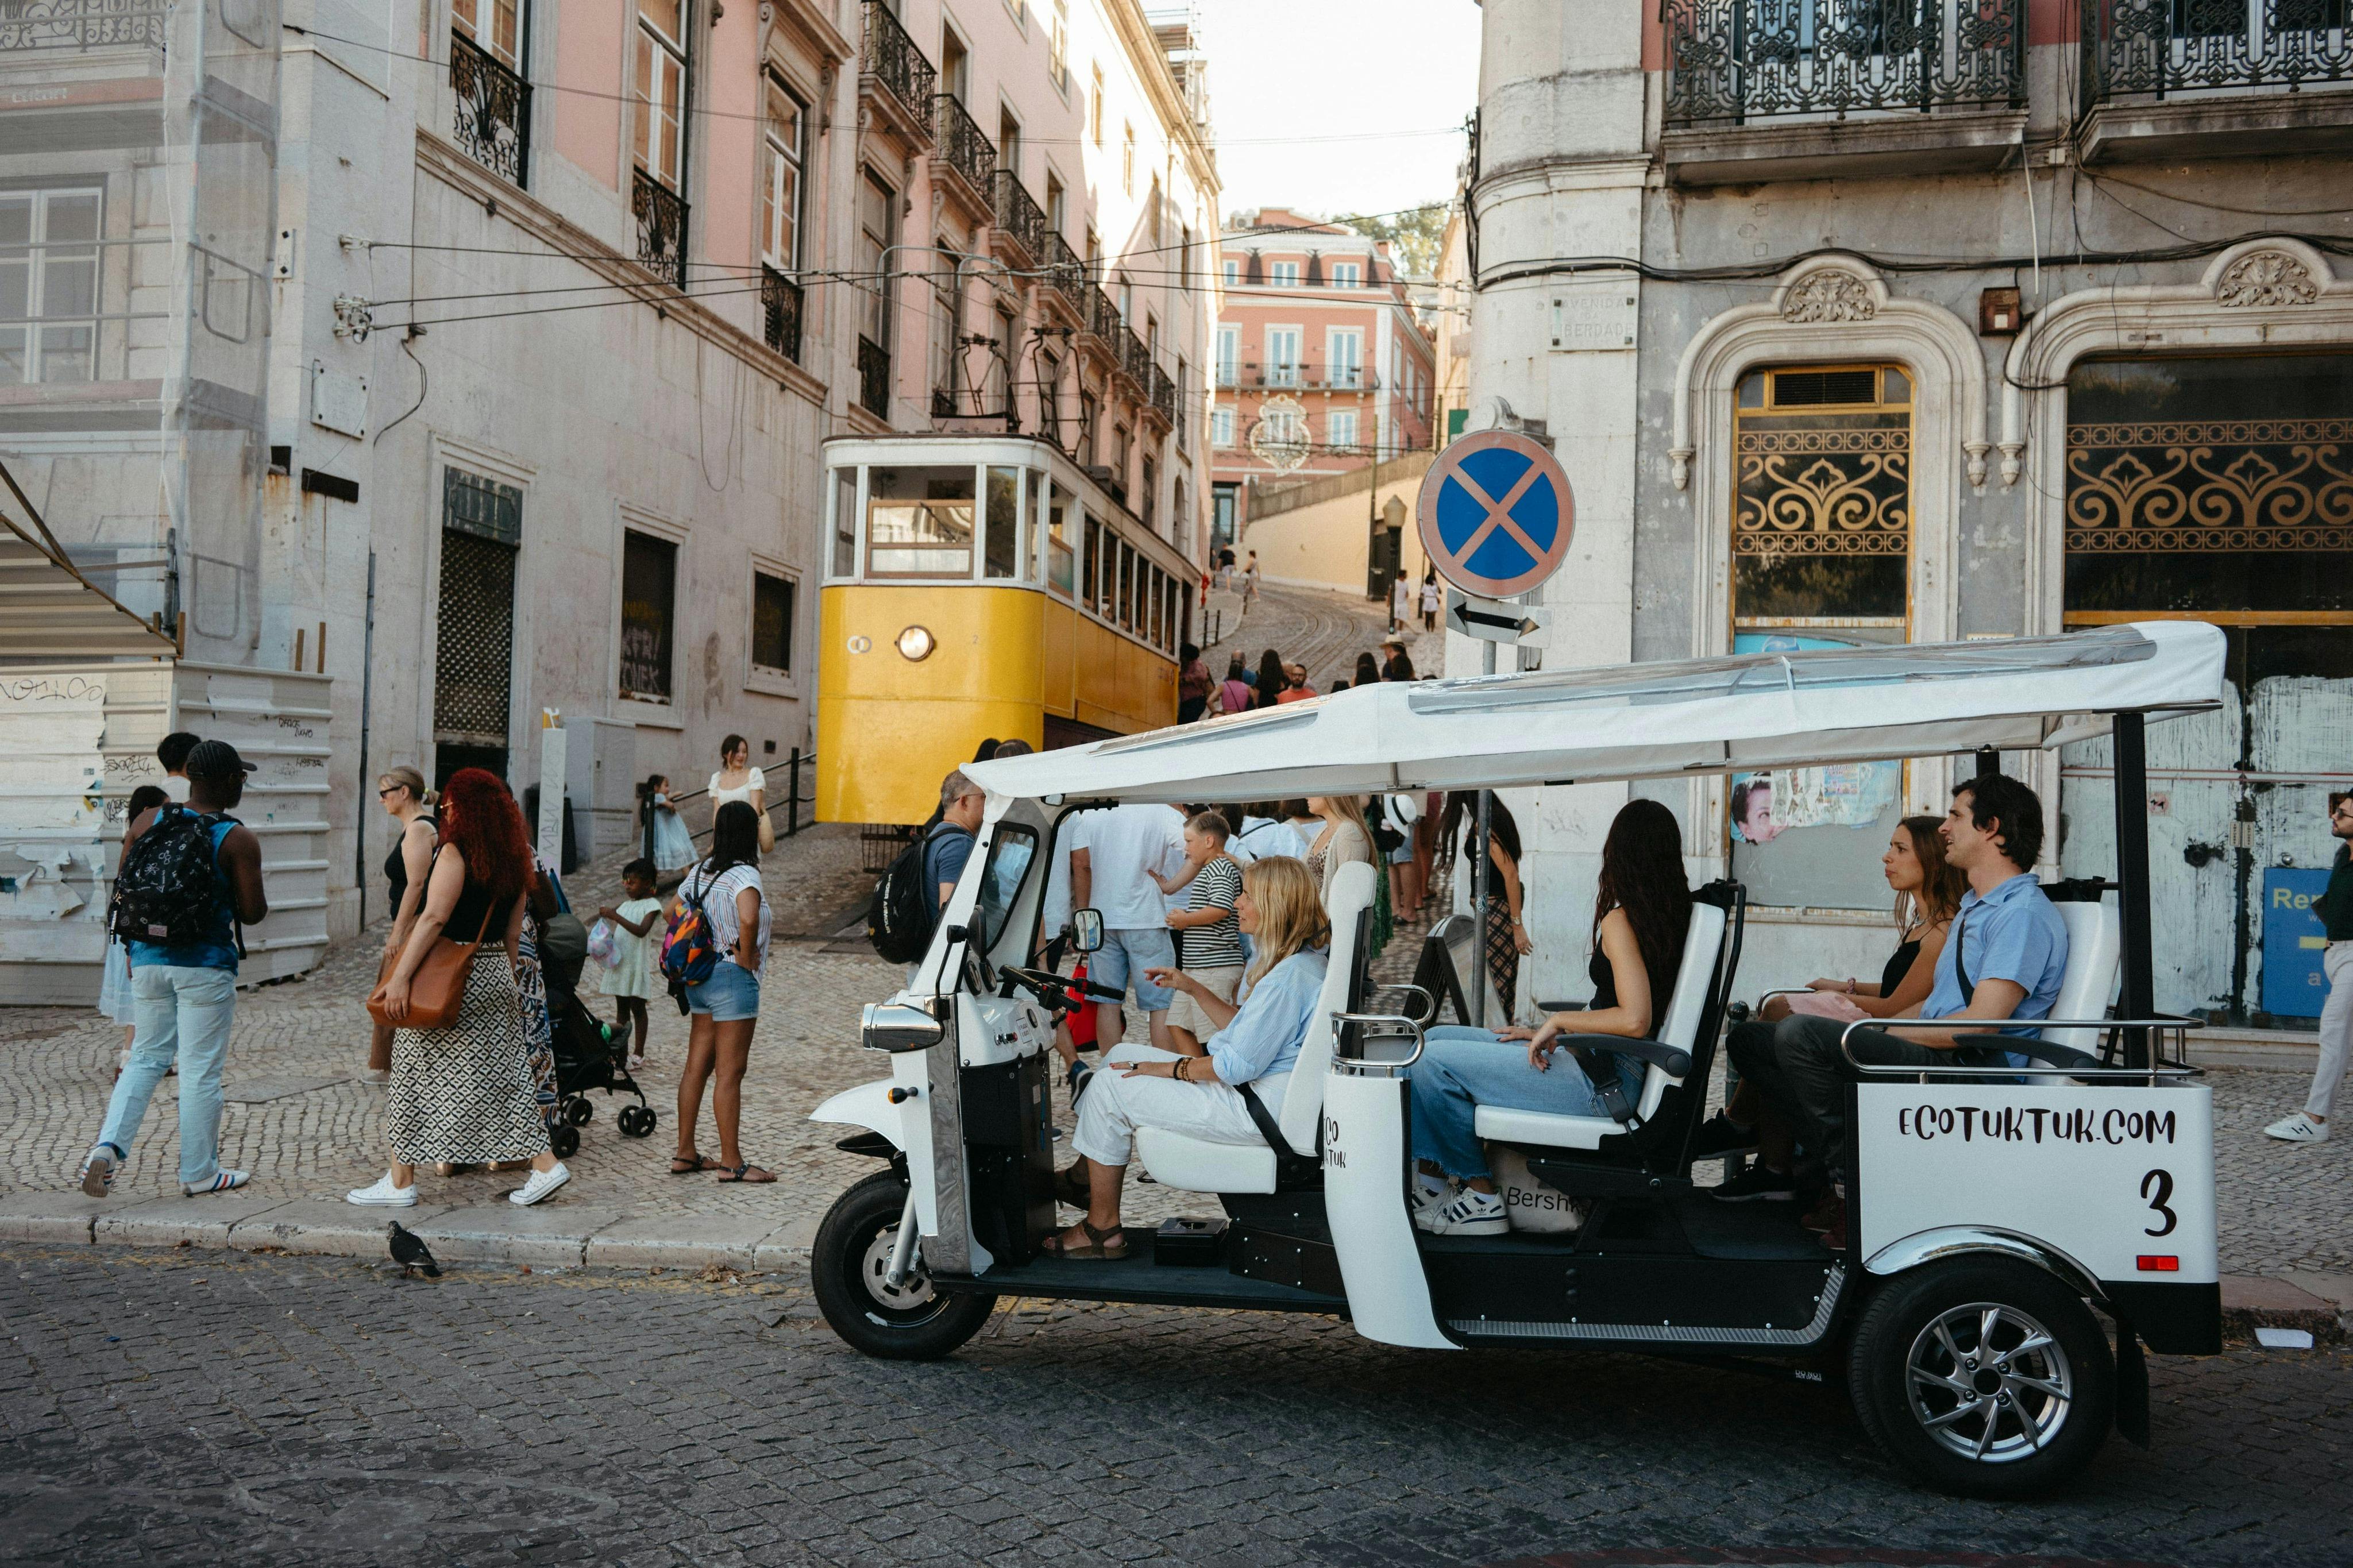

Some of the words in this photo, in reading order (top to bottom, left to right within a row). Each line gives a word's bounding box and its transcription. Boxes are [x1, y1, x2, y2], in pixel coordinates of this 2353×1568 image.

[1562, 298, 1625, 309] AVENIDA
[1550, 322, 1634, 338] LIBERDADE
[883, 901, 891, 934] ARMOUR
[1324, 1117, 1338, 1146] CO
[1899, 1104, 2175, 1145] ECOTUKTUK.COM
[2140, 1168, 2177, 1237] 3
